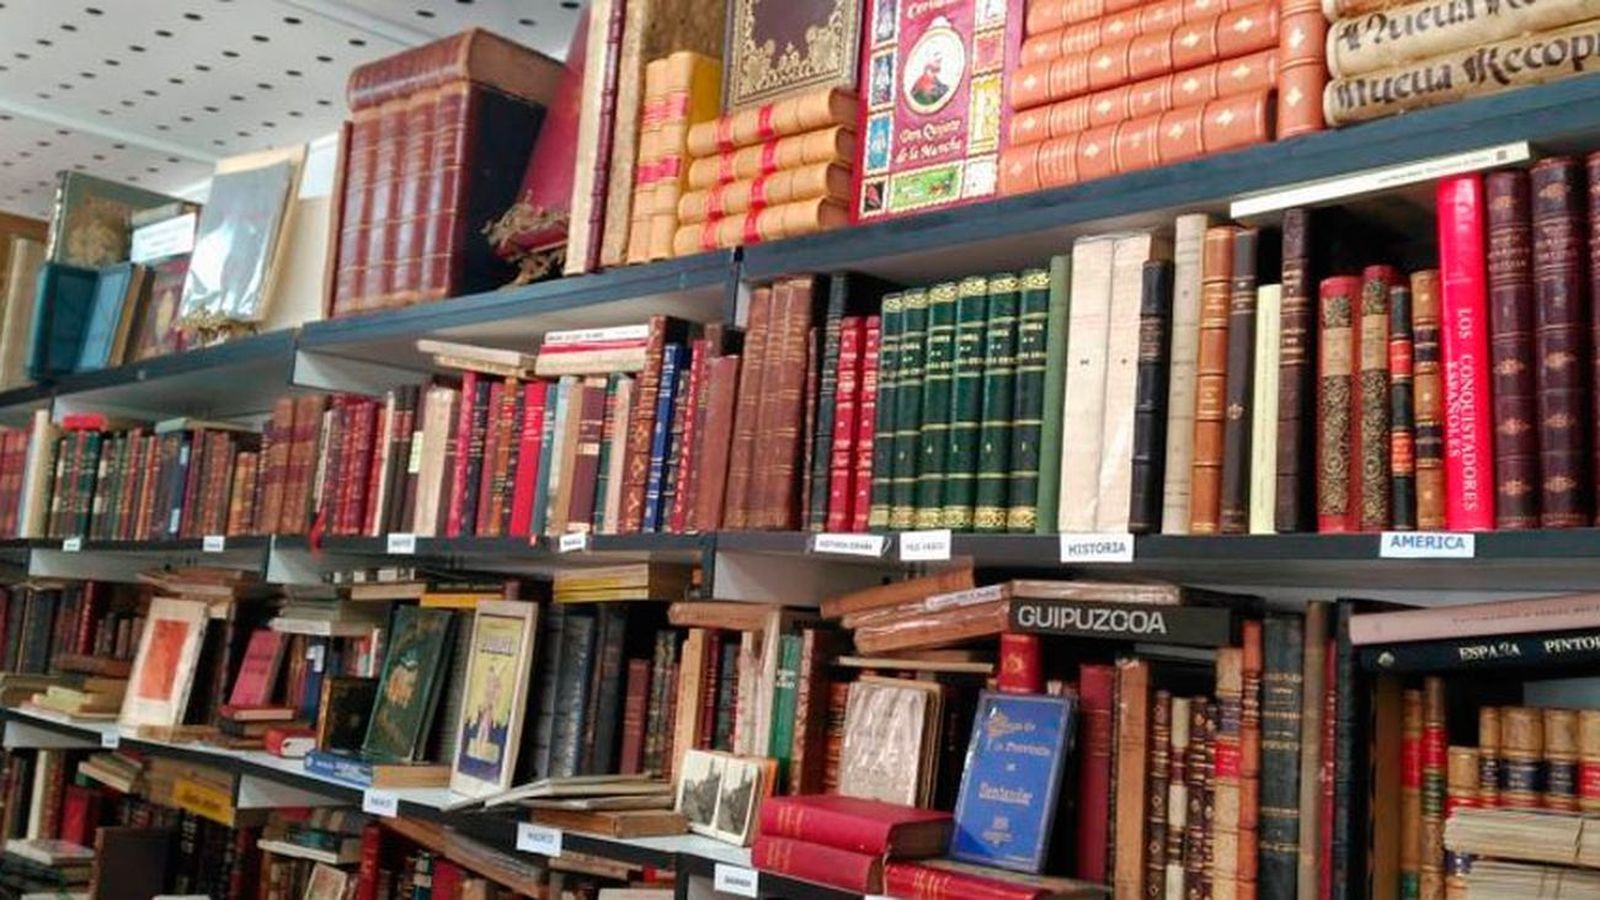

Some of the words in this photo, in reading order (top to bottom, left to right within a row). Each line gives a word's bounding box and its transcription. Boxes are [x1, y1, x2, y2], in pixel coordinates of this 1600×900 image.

[1457, 307, 1473, 340] LOS
[1458, 355, 1480, 512] CONQUISTADORES
[1068, 541, 1127, 557] HISTORIA
[1390, 534, 1466, 550] AMERICA
[1017, 605, 1167, 634] GUIPUZCOA
